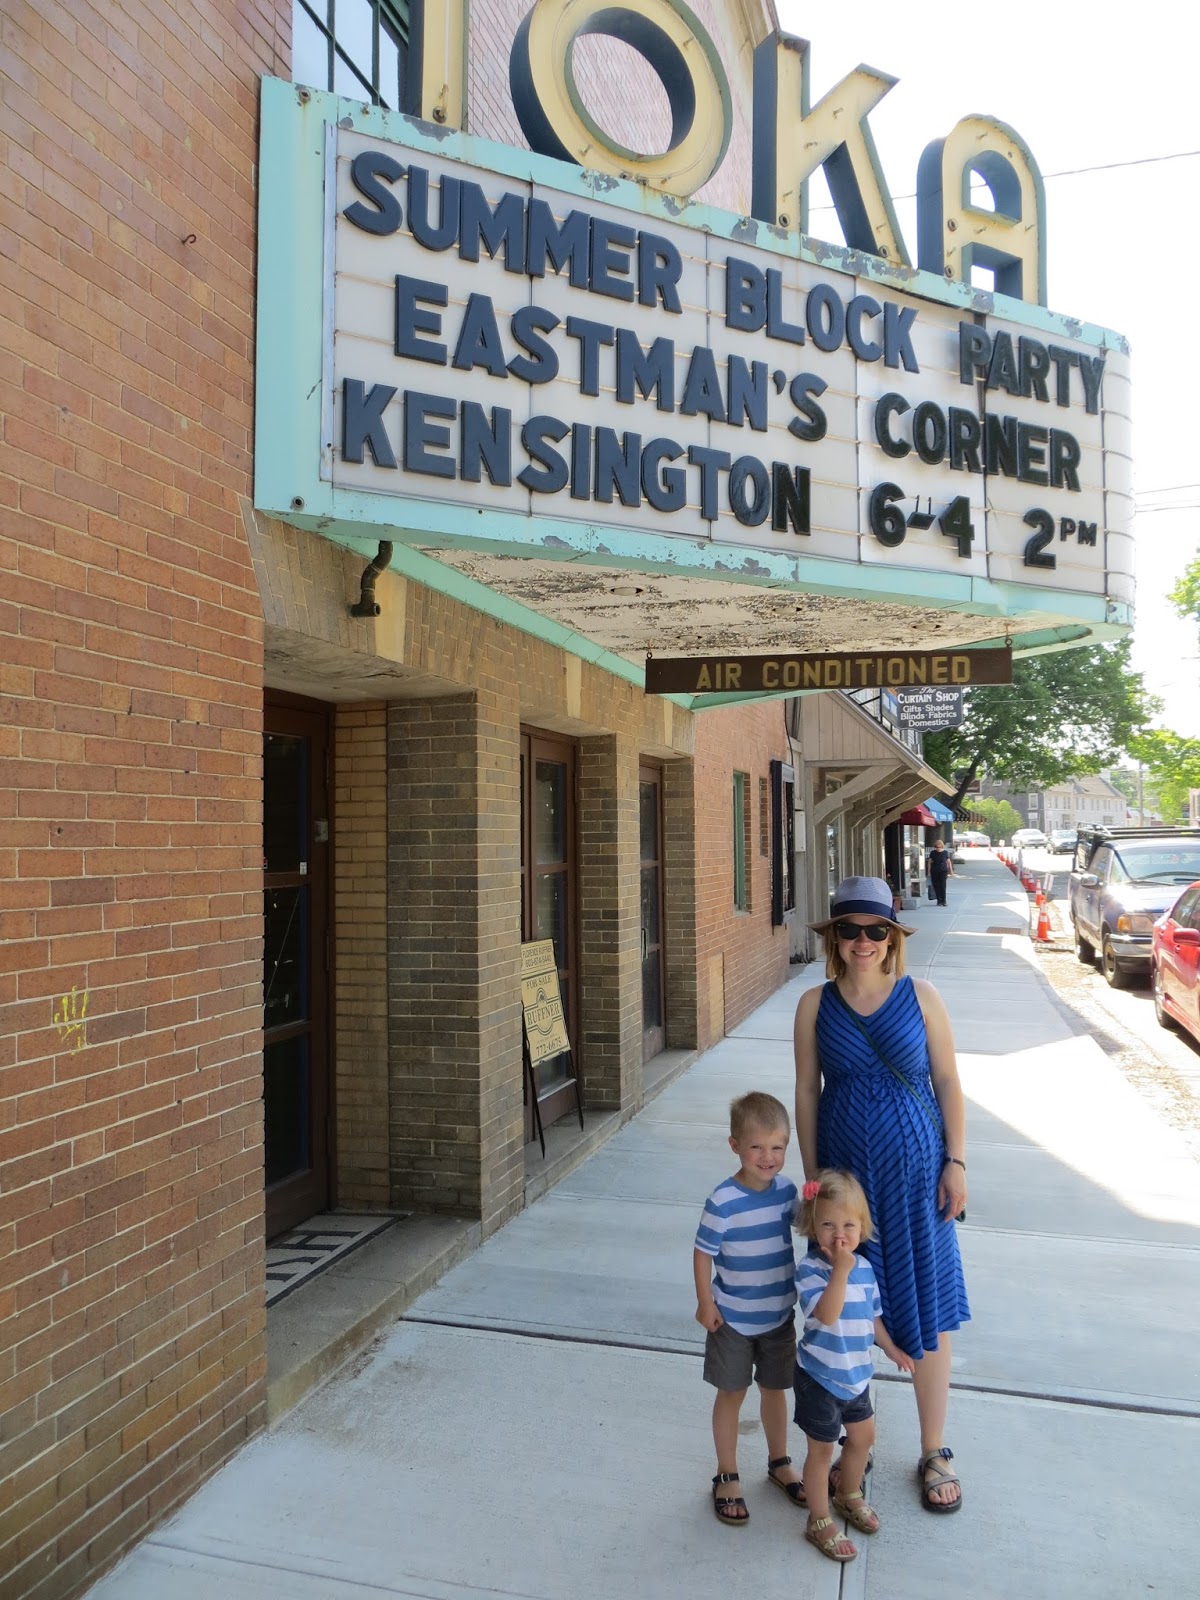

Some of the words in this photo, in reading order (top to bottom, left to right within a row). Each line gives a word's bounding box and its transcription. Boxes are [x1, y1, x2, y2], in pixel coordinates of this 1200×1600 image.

[343, 150, 683, 314] SUMMER
[725, 256, 920, 374] BLOCK
[958, 320, 1106, 415] PARTY
[395, 274, 828, 442] EASTMAN'S
[874, 392, 1082, 492] CORNER
[341, 377, 811, 536] KENSINGTON
[869, 482, 975, 559] 6-4
[696, 662, 742, 689] AIR
[762, 655, 972, 688] CONDITIONED
[897, 693, 932, 703] CURTAIN
[936, 691, 959, 701] SHOP
[919, 687, 937, 695] The
[925, 703, 954, 712] Shades
[928, 711, 957, 719] Fabrics
[908, 719, 949, 727] Domestics
[526, 979, 538, 990] FOR
[538, 974, 552, 986] SALE
[526, 1002, 560, 1026] RUFFNER
